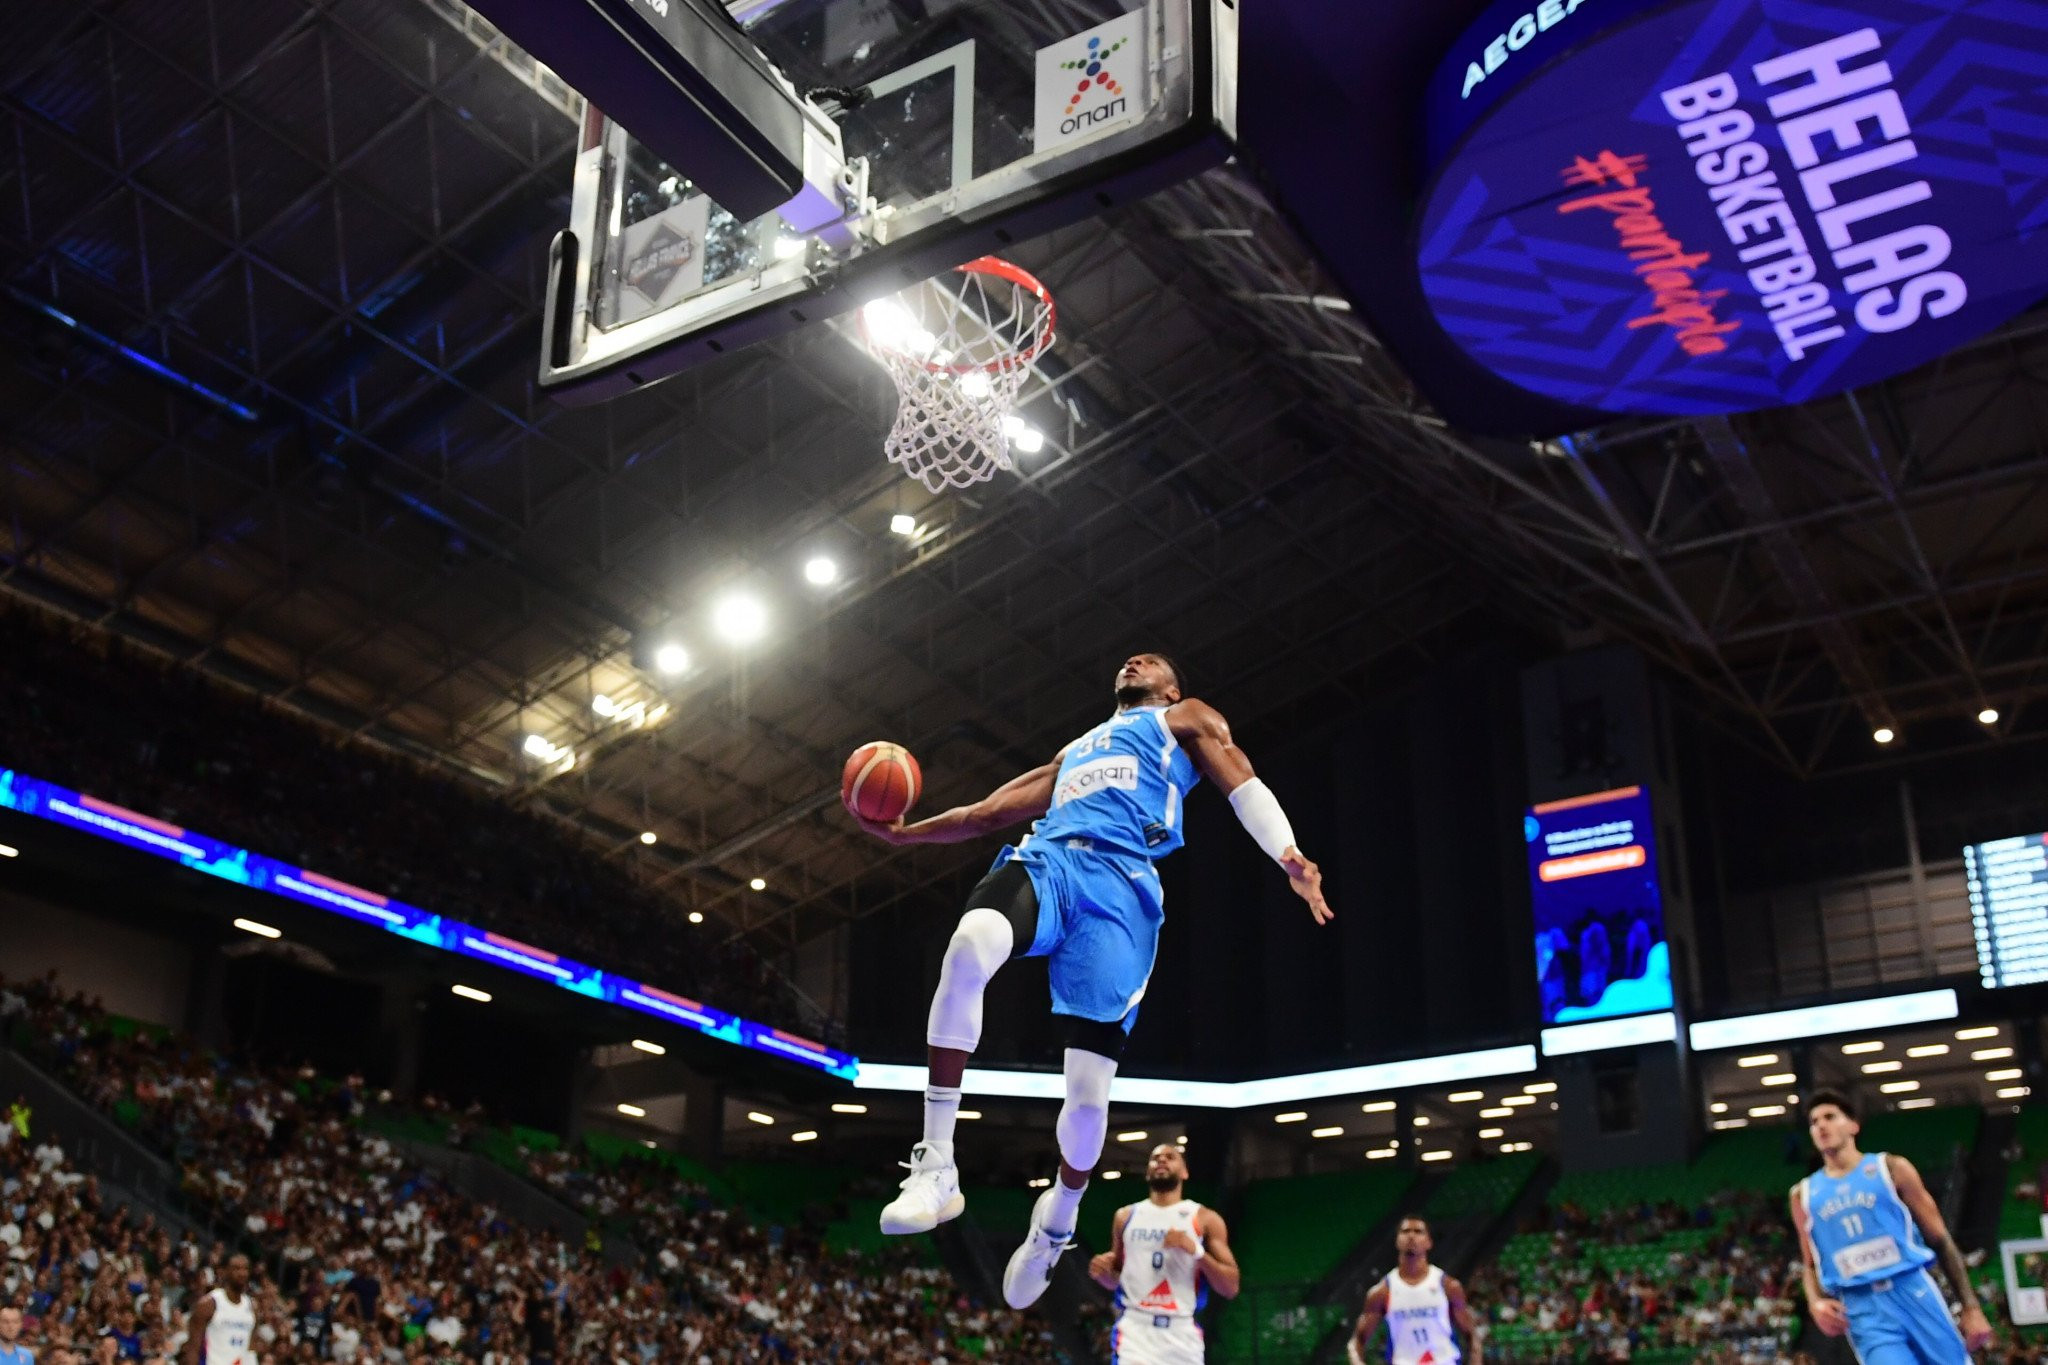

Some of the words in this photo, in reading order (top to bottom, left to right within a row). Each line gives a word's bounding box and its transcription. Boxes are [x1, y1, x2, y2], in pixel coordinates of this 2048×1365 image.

[1752, 27, 1967, 333] HELLAS
[1661, 71, 1846, 362] BASKETBALL
[1077, 727, 1113, 758] 34
[1818, 1190, 1877, 1221] HELLAS
[1842, 1213, 1864, 1238] 11
[1152, 1251, 1164, 1270] 0
